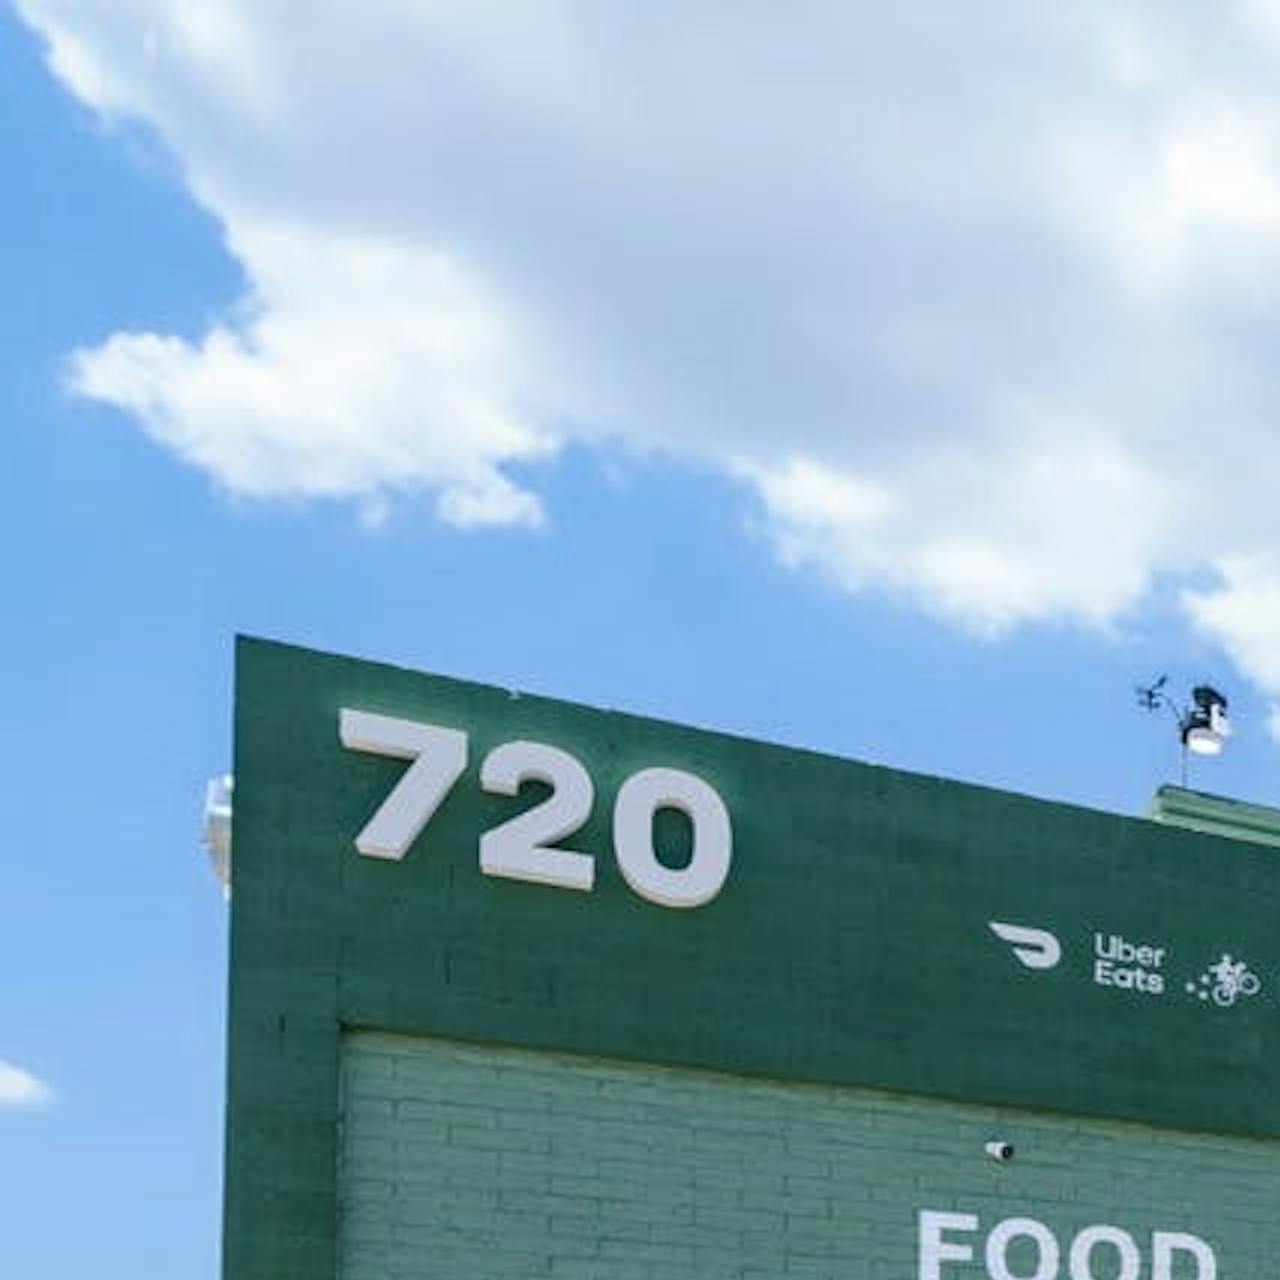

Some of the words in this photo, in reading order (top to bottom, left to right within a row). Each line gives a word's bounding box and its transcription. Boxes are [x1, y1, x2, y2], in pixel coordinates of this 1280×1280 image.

[339, 706, 733, 909] 720
[1094, 932, 1165, 966] Uber
[1094, 961, 1164, 994] Eats
